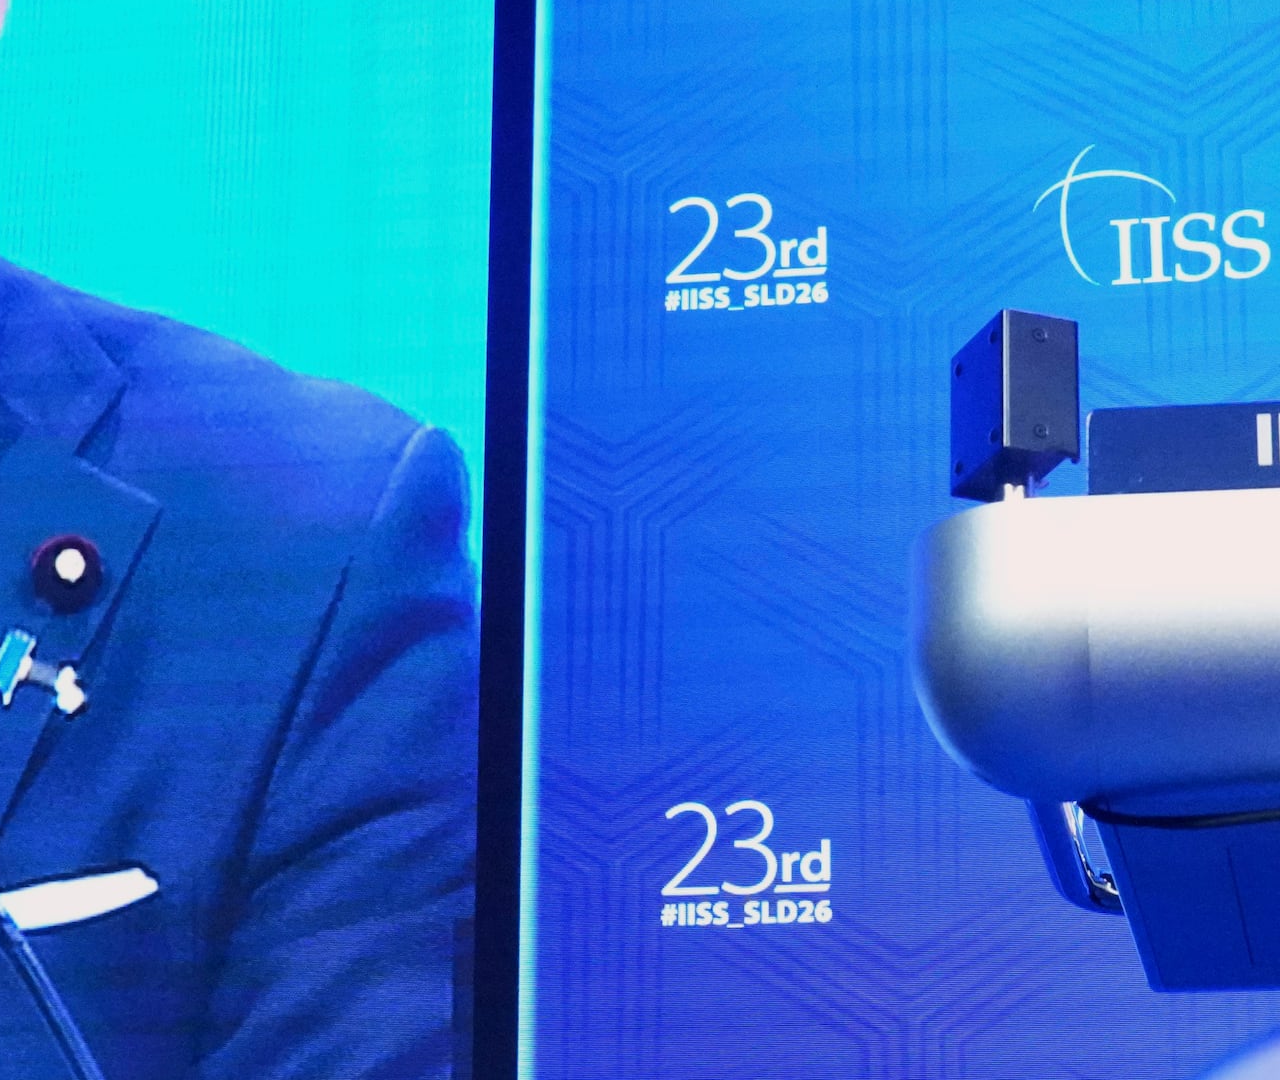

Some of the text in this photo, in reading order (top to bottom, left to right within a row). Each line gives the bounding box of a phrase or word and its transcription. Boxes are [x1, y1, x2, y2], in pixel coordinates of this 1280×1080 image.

[665, 193, 827, 284] 23rd
[1110, 209, 1271, 285] IISS
[665, 282, 829, 311] #IISS_SLD26
[661, 800, 832, 896] 23rd
[660, 899, 833, 929] #IISS_SLD26
